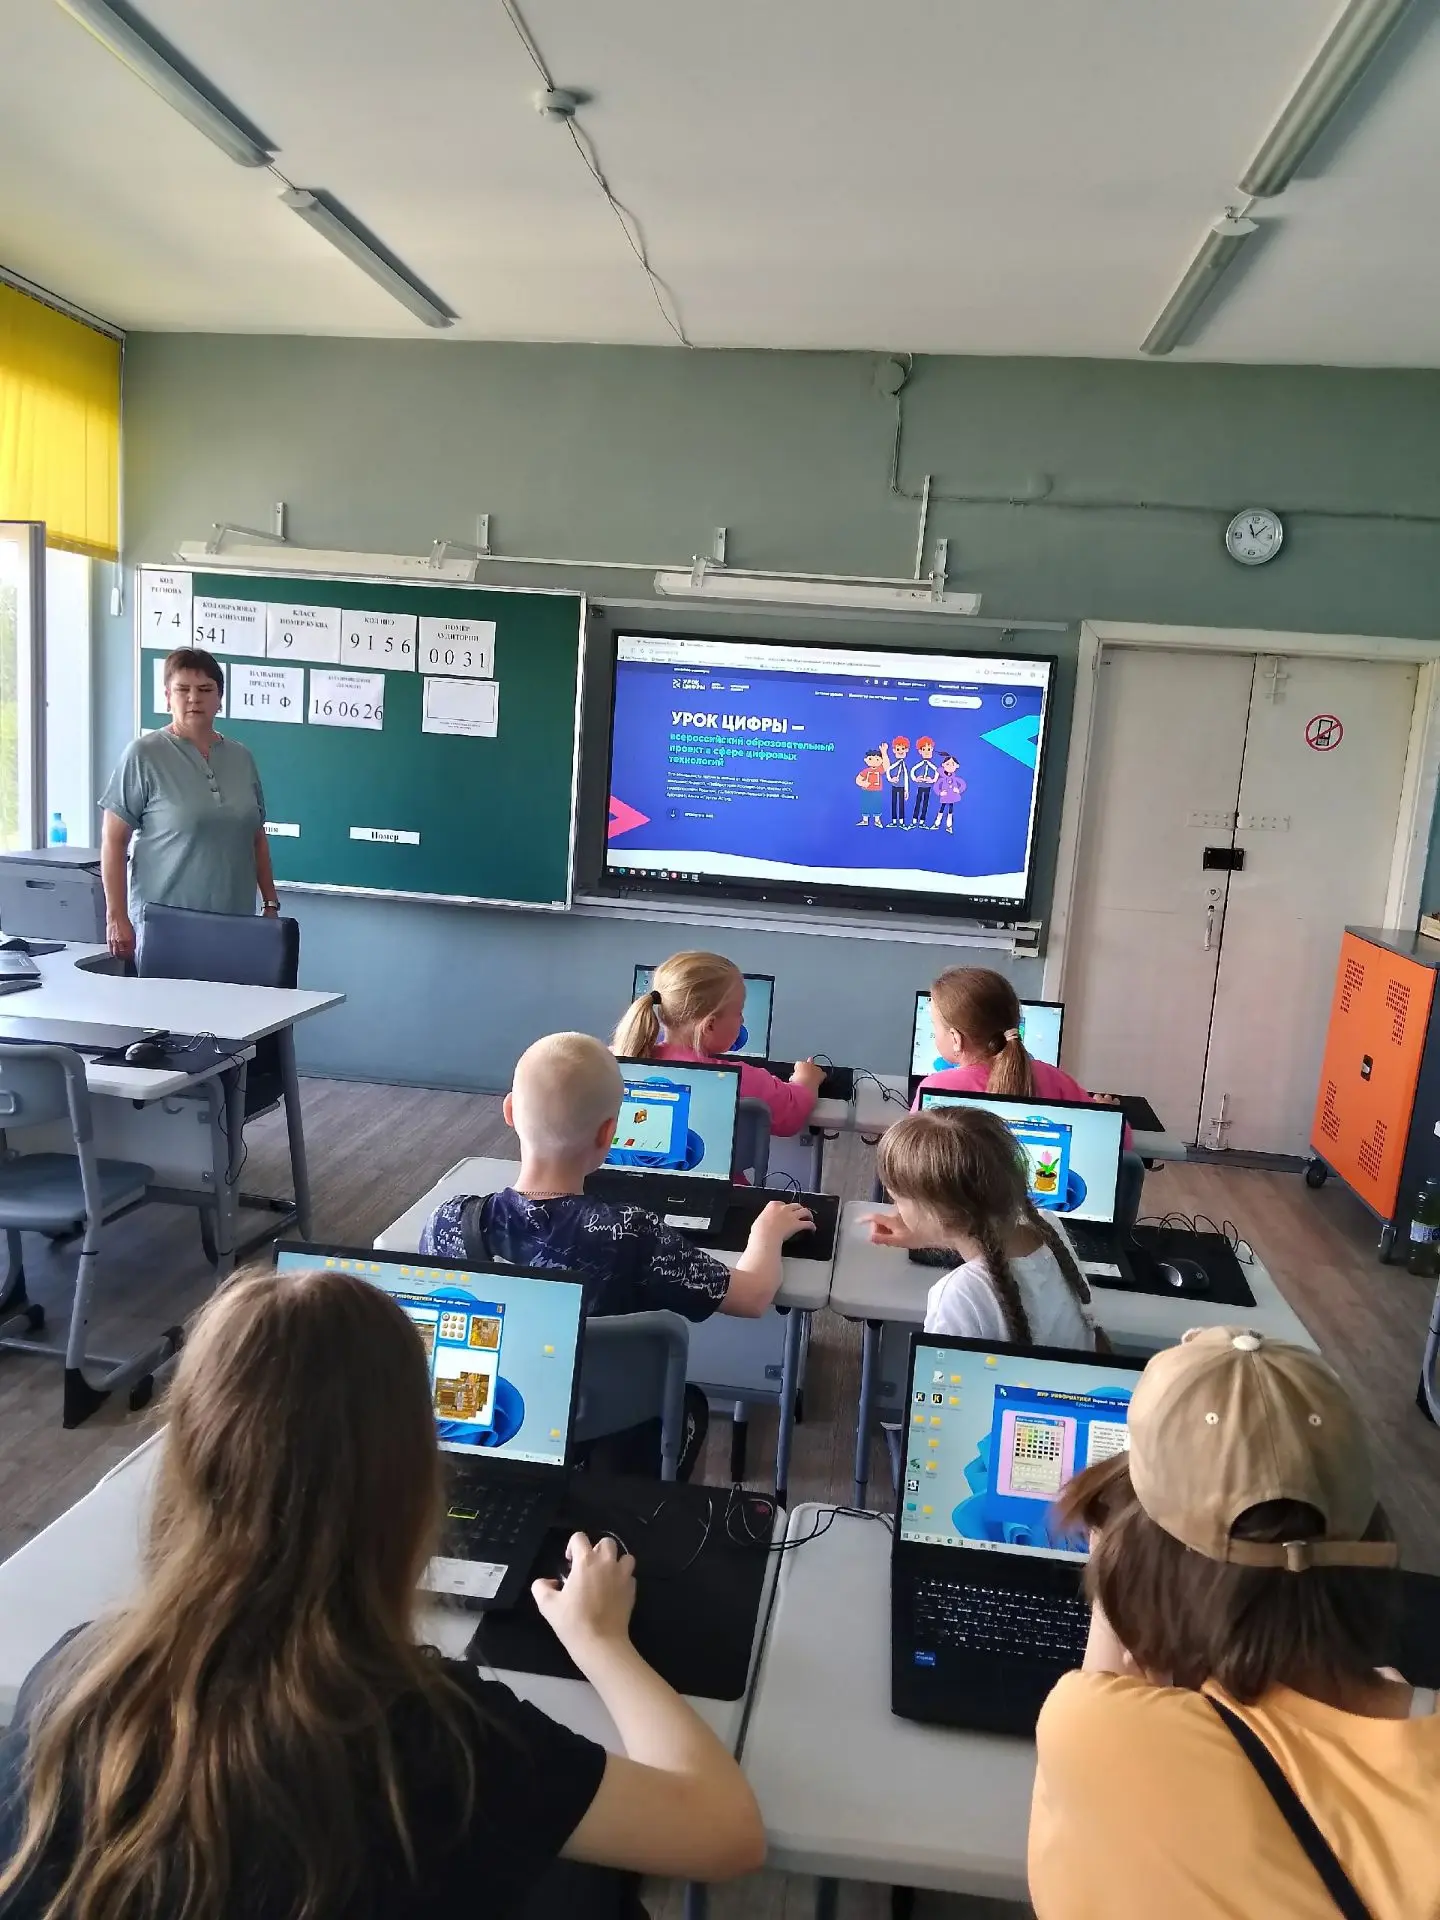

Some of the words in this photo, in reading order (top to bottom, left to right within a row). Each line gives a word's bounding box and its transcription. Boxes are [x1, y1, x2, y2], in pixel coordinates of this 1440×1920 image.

[195, 626, 226, 645] 541
[283, 632, 294, 649] 9
[671, 710, 719, 729] УРОК
[721, 714, 788, 734] ЦИФРЫ
[713, 746, 744, 758] сфере
[668, 756, 725, 767] технологий
